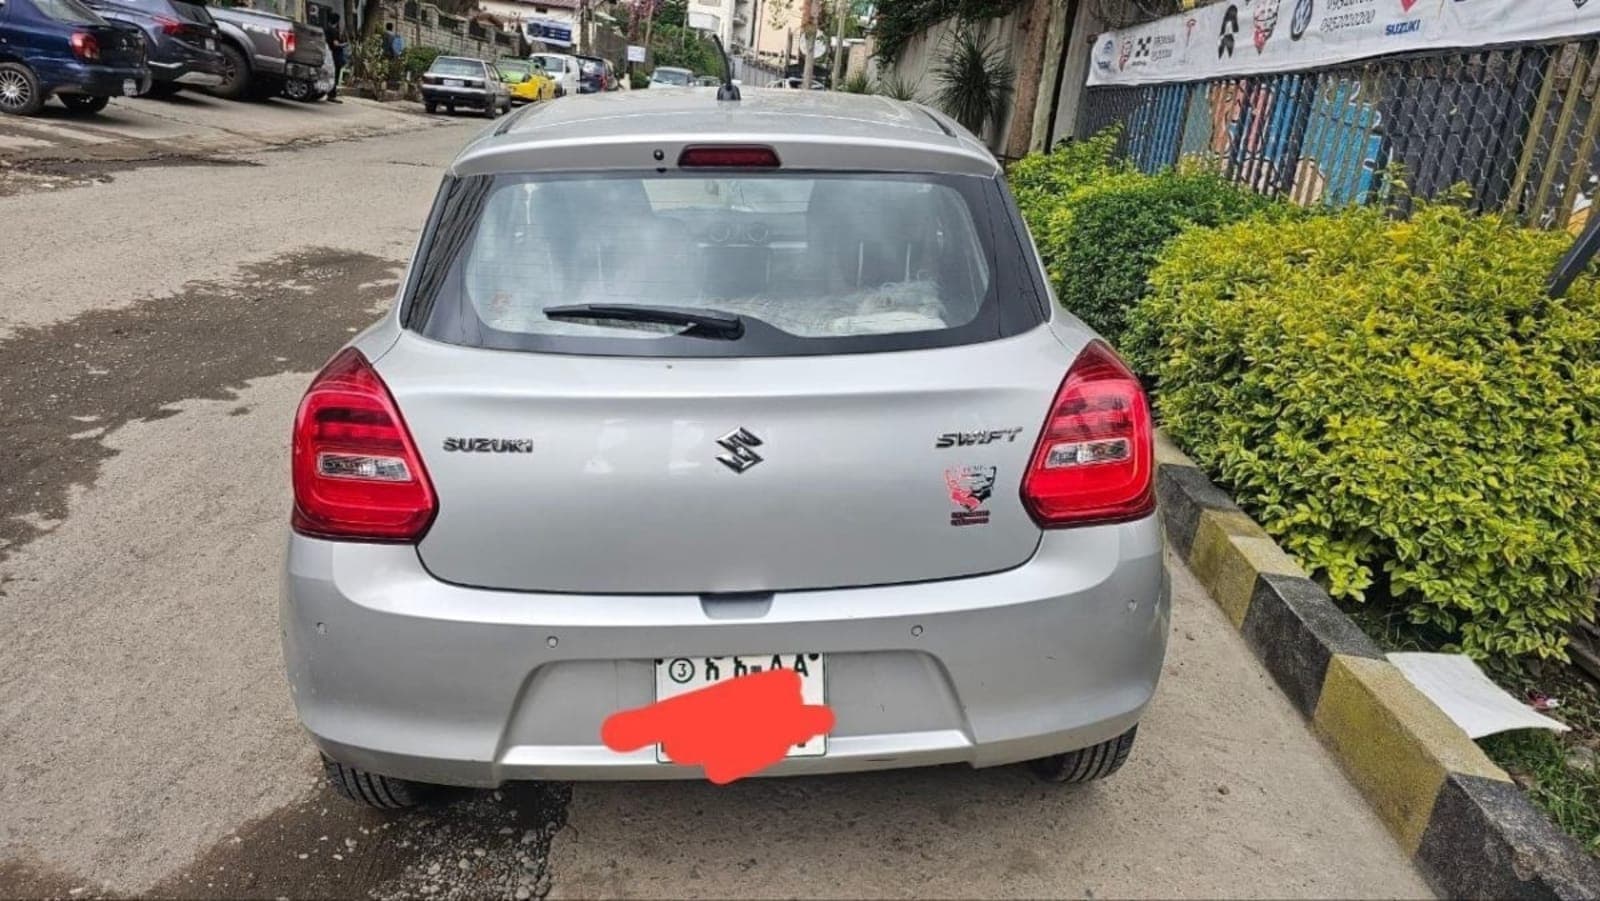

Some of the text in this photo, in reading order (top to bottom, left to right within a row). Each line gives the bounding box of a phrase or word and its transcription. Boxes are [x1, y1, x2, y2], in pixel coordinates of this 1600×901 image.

[1384, 19, 1421, 36] SUZUKI
[443, 437, 533, 453] SUZUKI
[936, 427, 1022, 449] SWIFT
